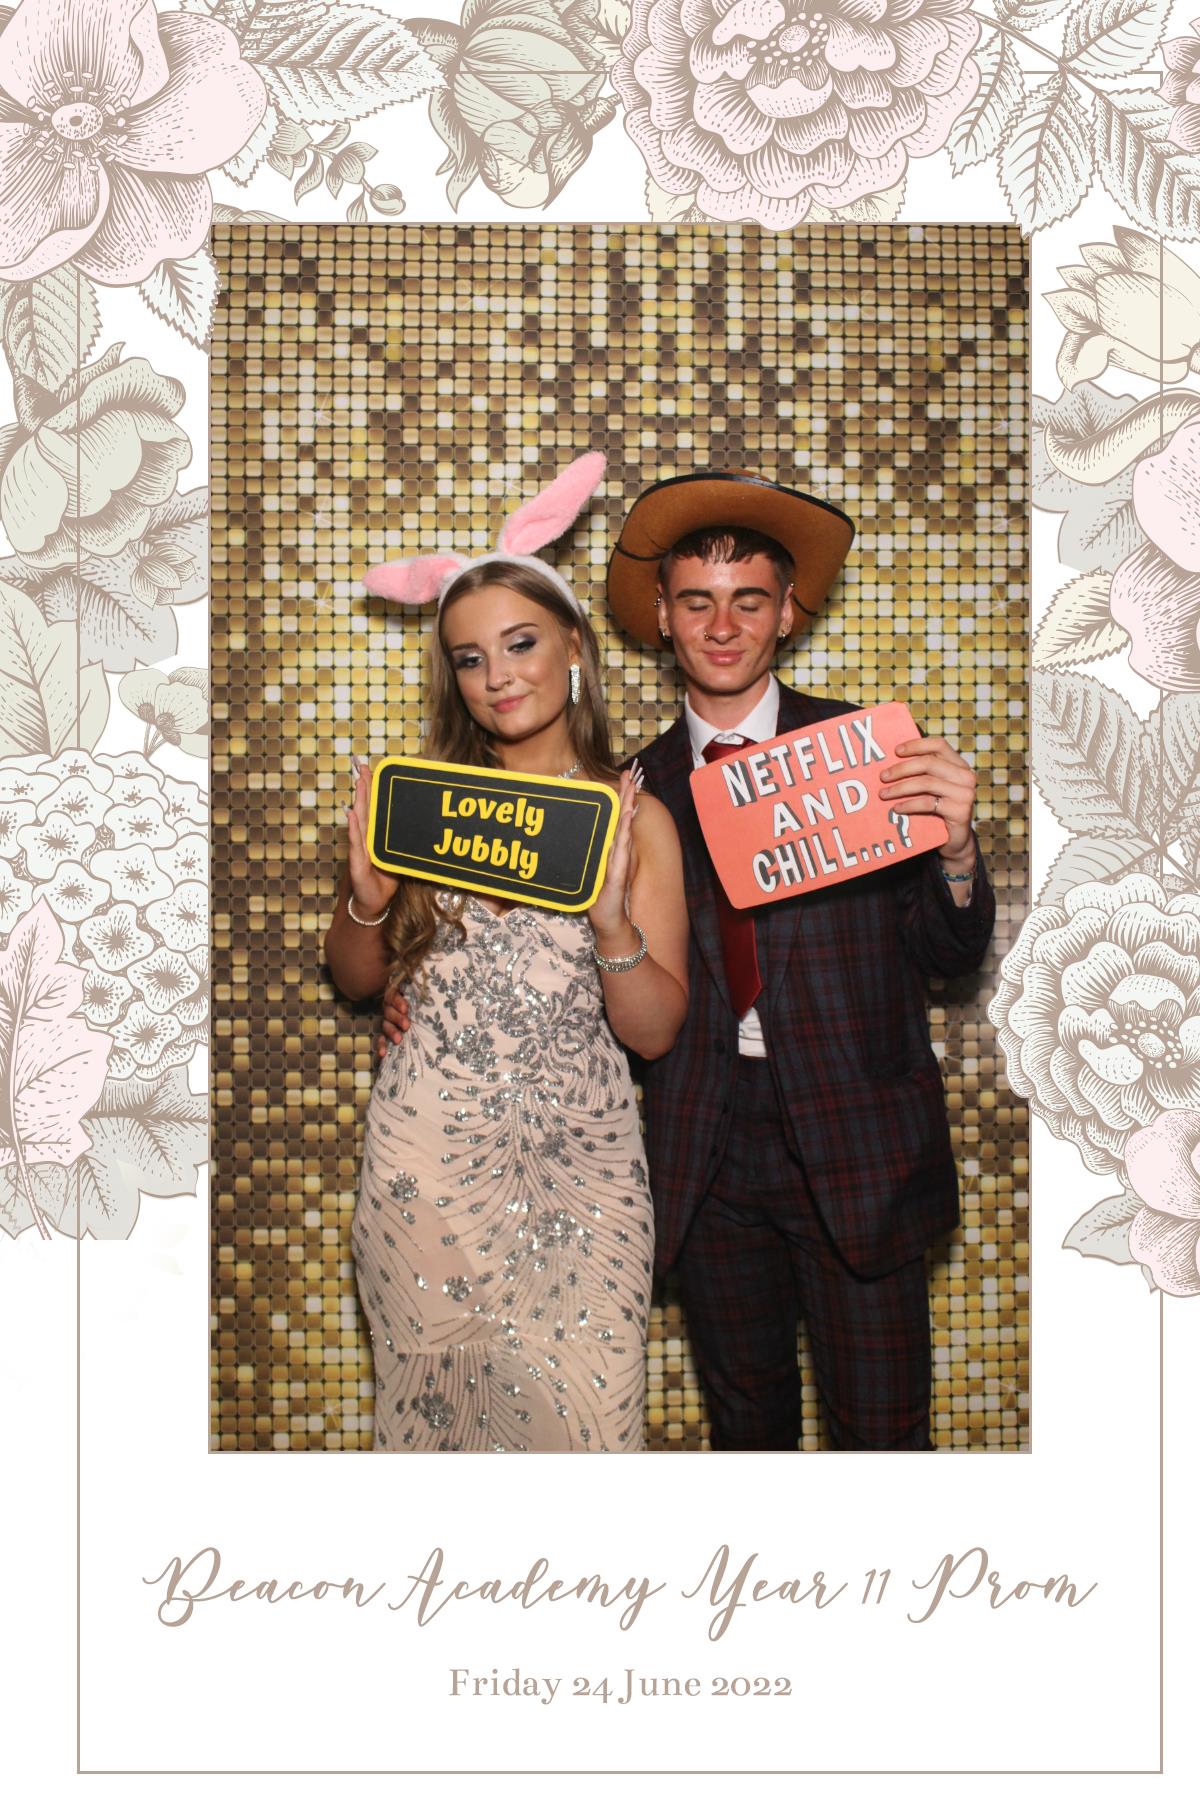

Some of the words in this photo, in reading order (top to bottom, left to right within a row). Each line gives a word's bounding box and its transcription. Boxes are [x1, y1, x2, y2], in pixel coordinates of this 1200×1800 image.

[720, 714, 886, 808] NETFLIX
[441, 790, 545, 837] Lovely
[773, 779, 869, 838] AND
[433, 828, 539, 880] Jubbly
[752, 807, 913, 893] CHILL...?
